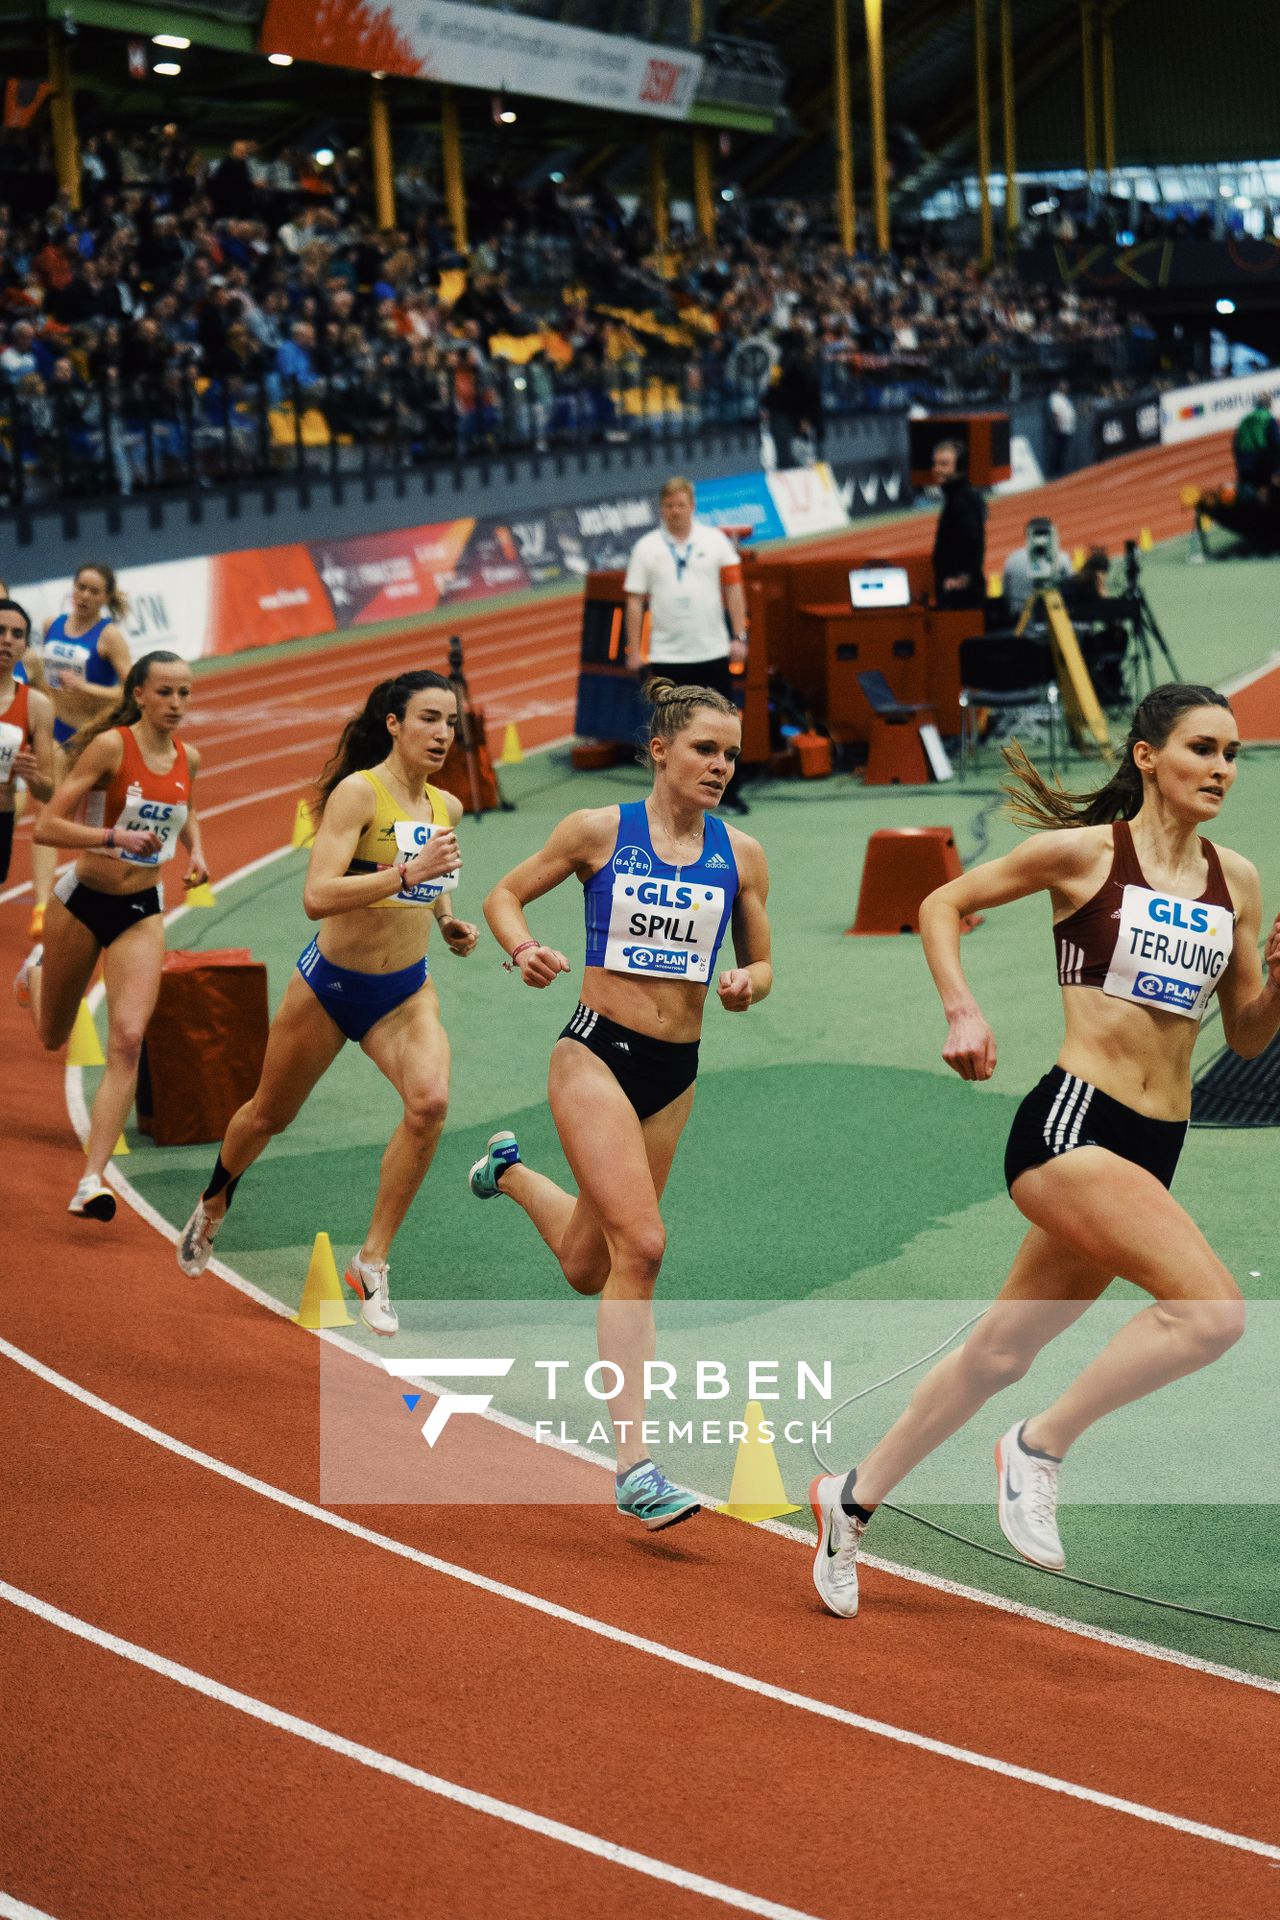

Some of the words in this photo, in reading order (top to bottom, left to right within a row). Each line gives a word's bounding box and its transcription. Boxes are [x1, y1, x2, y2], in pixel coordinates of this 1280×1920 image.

[615, 858, 649, 870] BAYER
[629, 913, 698, 943] SPILL
[656, 953, 686, 966] PLAN
[1130, 926, 1224, 978] TERJUNG
[1165, 982, 1199, 1001] PLAN
